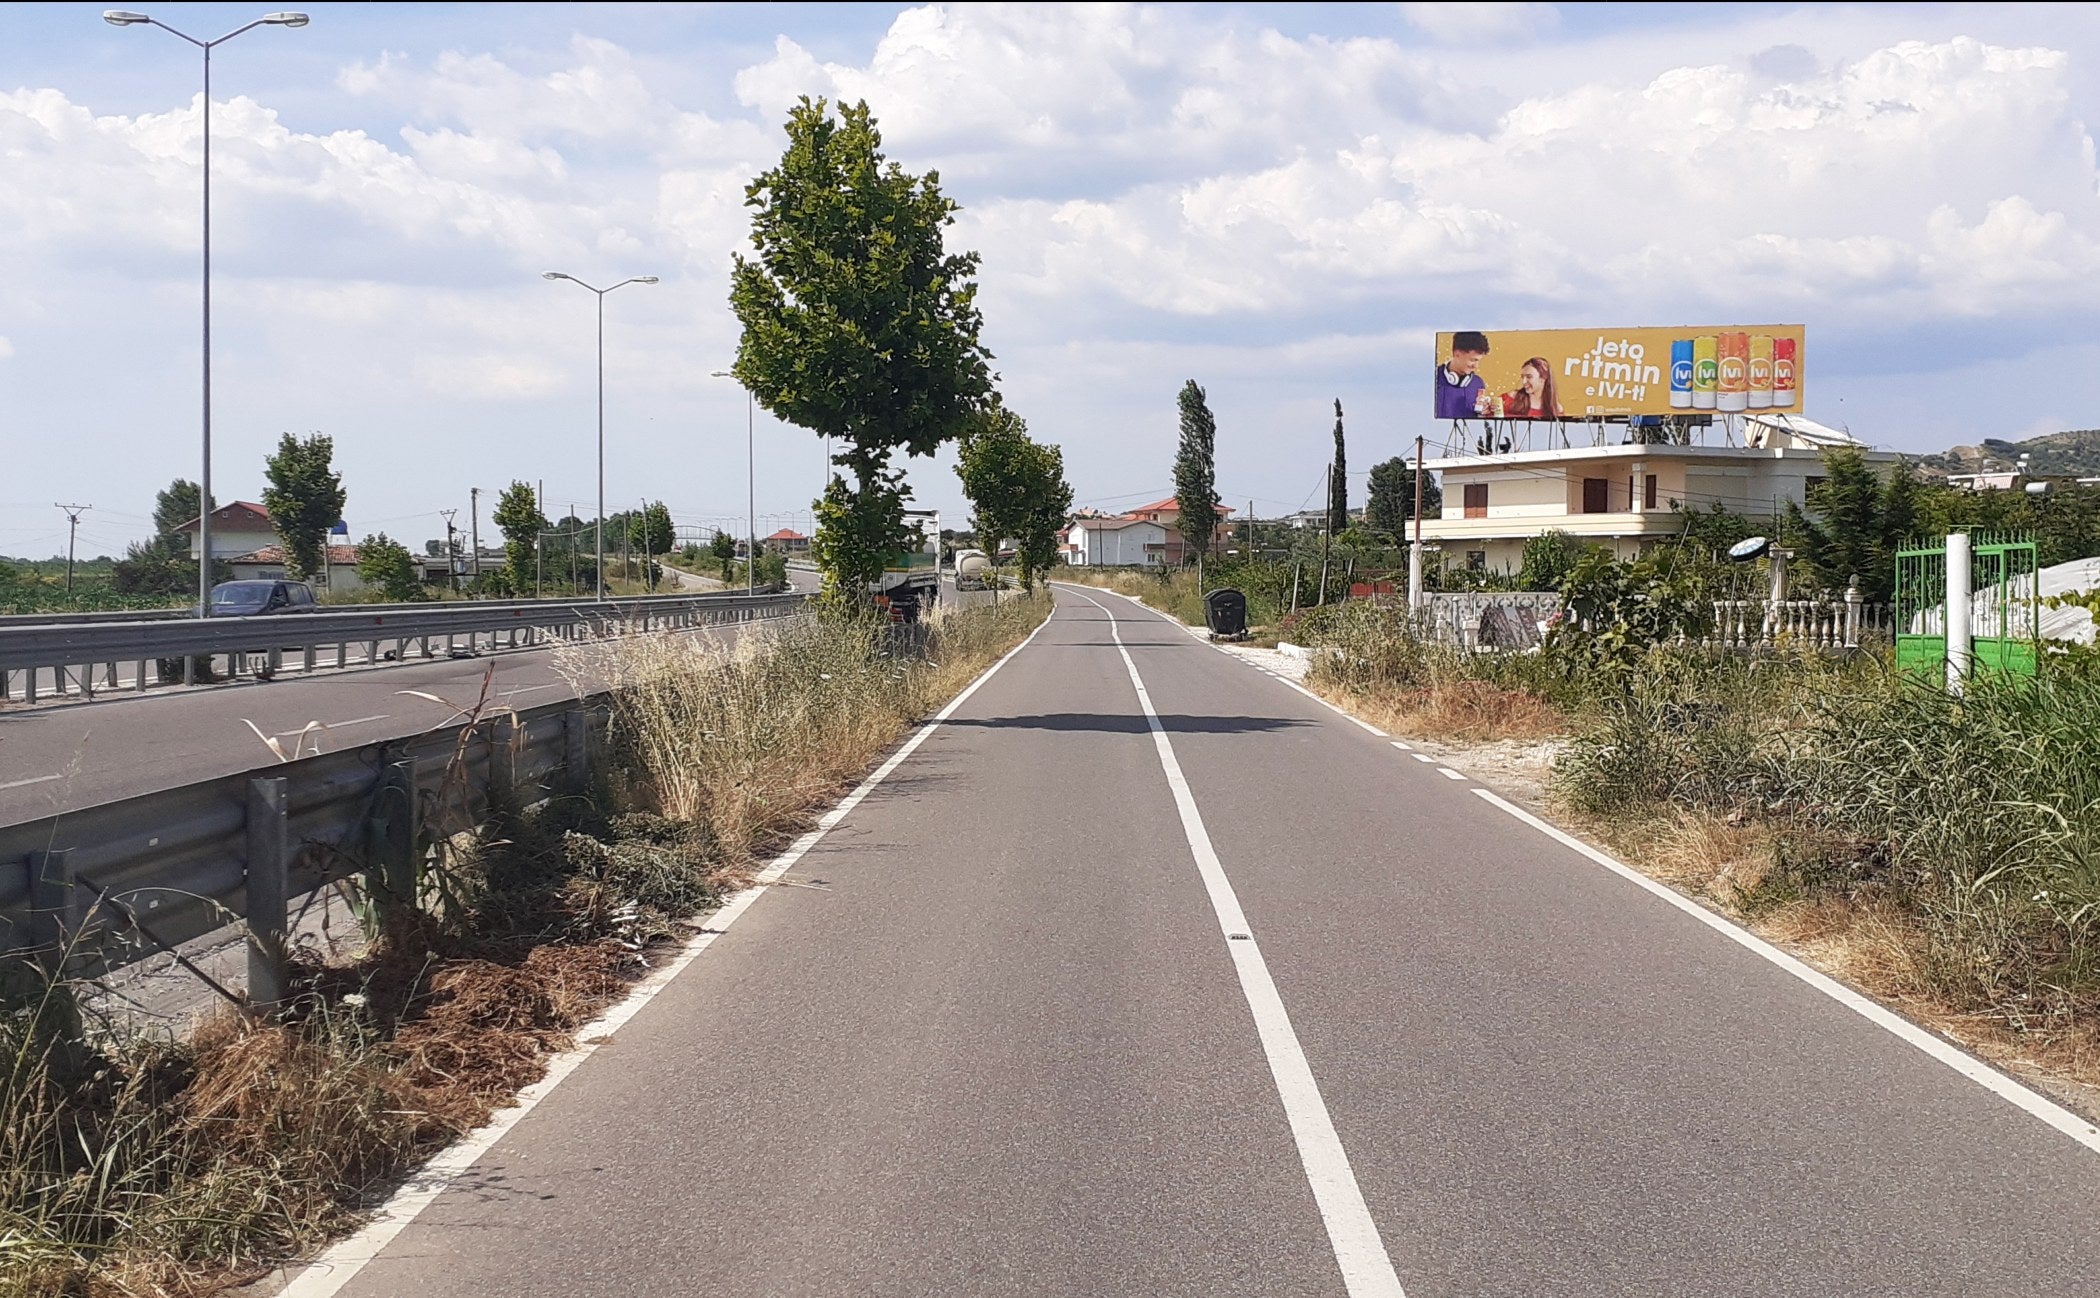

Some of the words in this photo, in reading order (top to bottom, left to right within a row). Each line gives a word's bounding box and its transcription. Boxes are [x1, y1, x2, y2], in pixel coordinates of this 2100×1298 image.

[1590, 336, 1645, 360] Jeto
[1564, 353, 1661, 385] ritmin
[1585, 386, 1595, 396] e
[1598, 381, 1646, 402] IVI-t!
